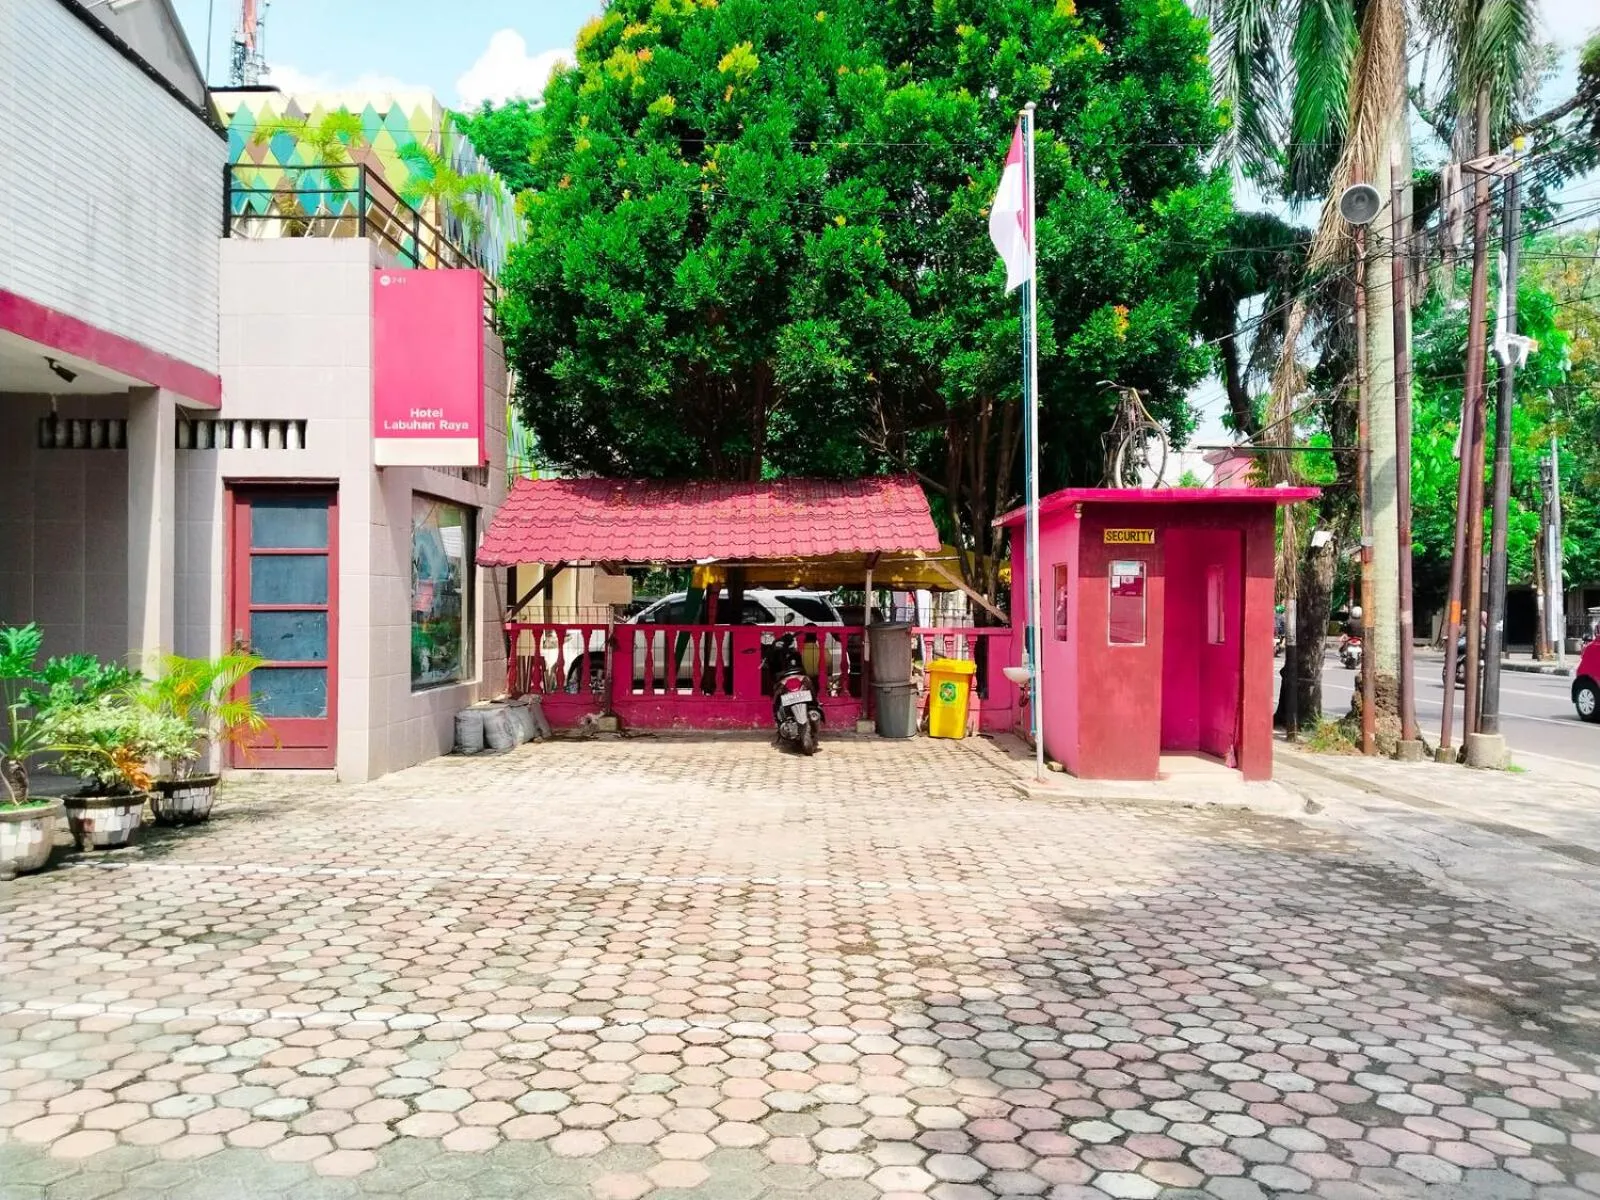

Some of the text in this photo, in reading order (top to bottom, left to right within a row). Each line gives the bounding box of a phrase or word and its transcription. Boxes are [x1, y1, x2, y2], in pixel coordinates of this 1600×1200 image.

[410, 408, 443, 418] Hotel
[383, 420, 469, 432] Labuhan Raya
[1105, 530, 1153, 542] SECURITY
